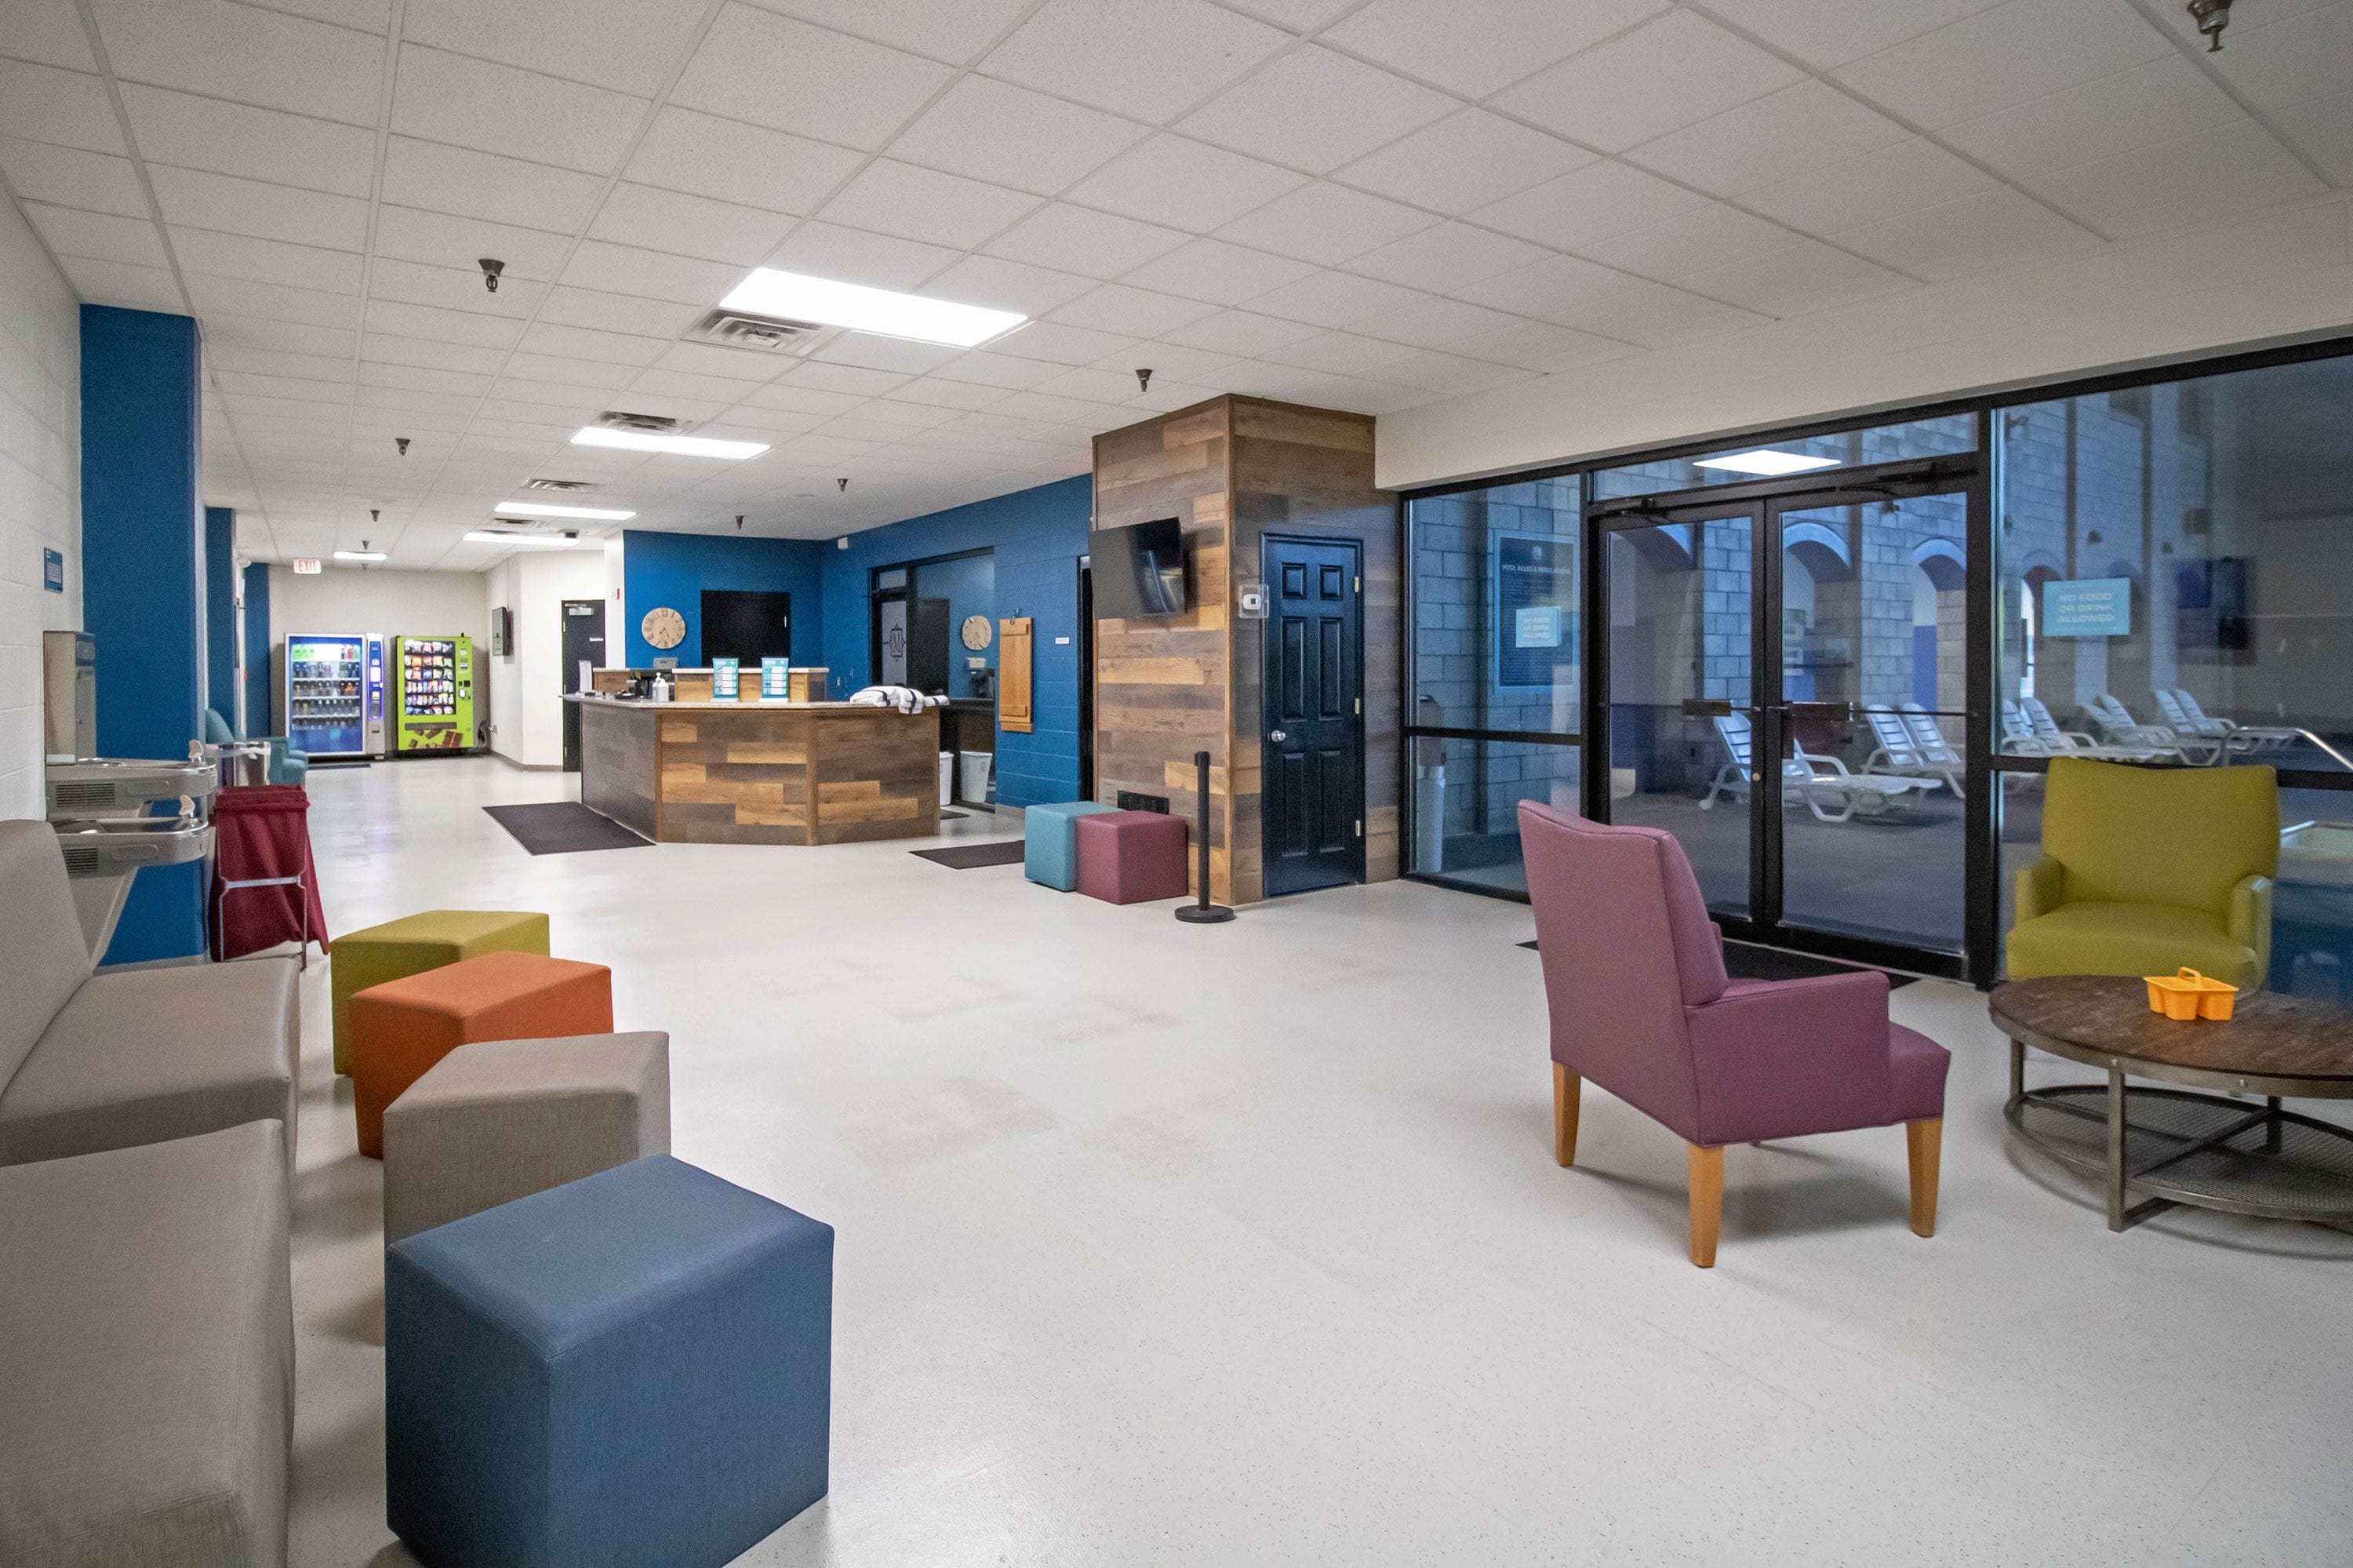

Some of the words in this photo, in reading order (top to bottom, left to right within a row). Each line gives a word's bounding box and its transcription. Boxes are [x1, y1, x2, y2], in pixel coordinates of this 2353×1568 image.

[299, 559, 317, 572] EXIT
[2079, 592, 2112, 602] FOOD
[2058, 604, 2075, 613] OR
[2078, 603, 2113, 612] DRINK
[2057, 614, 2113, 624] ALLOWED
